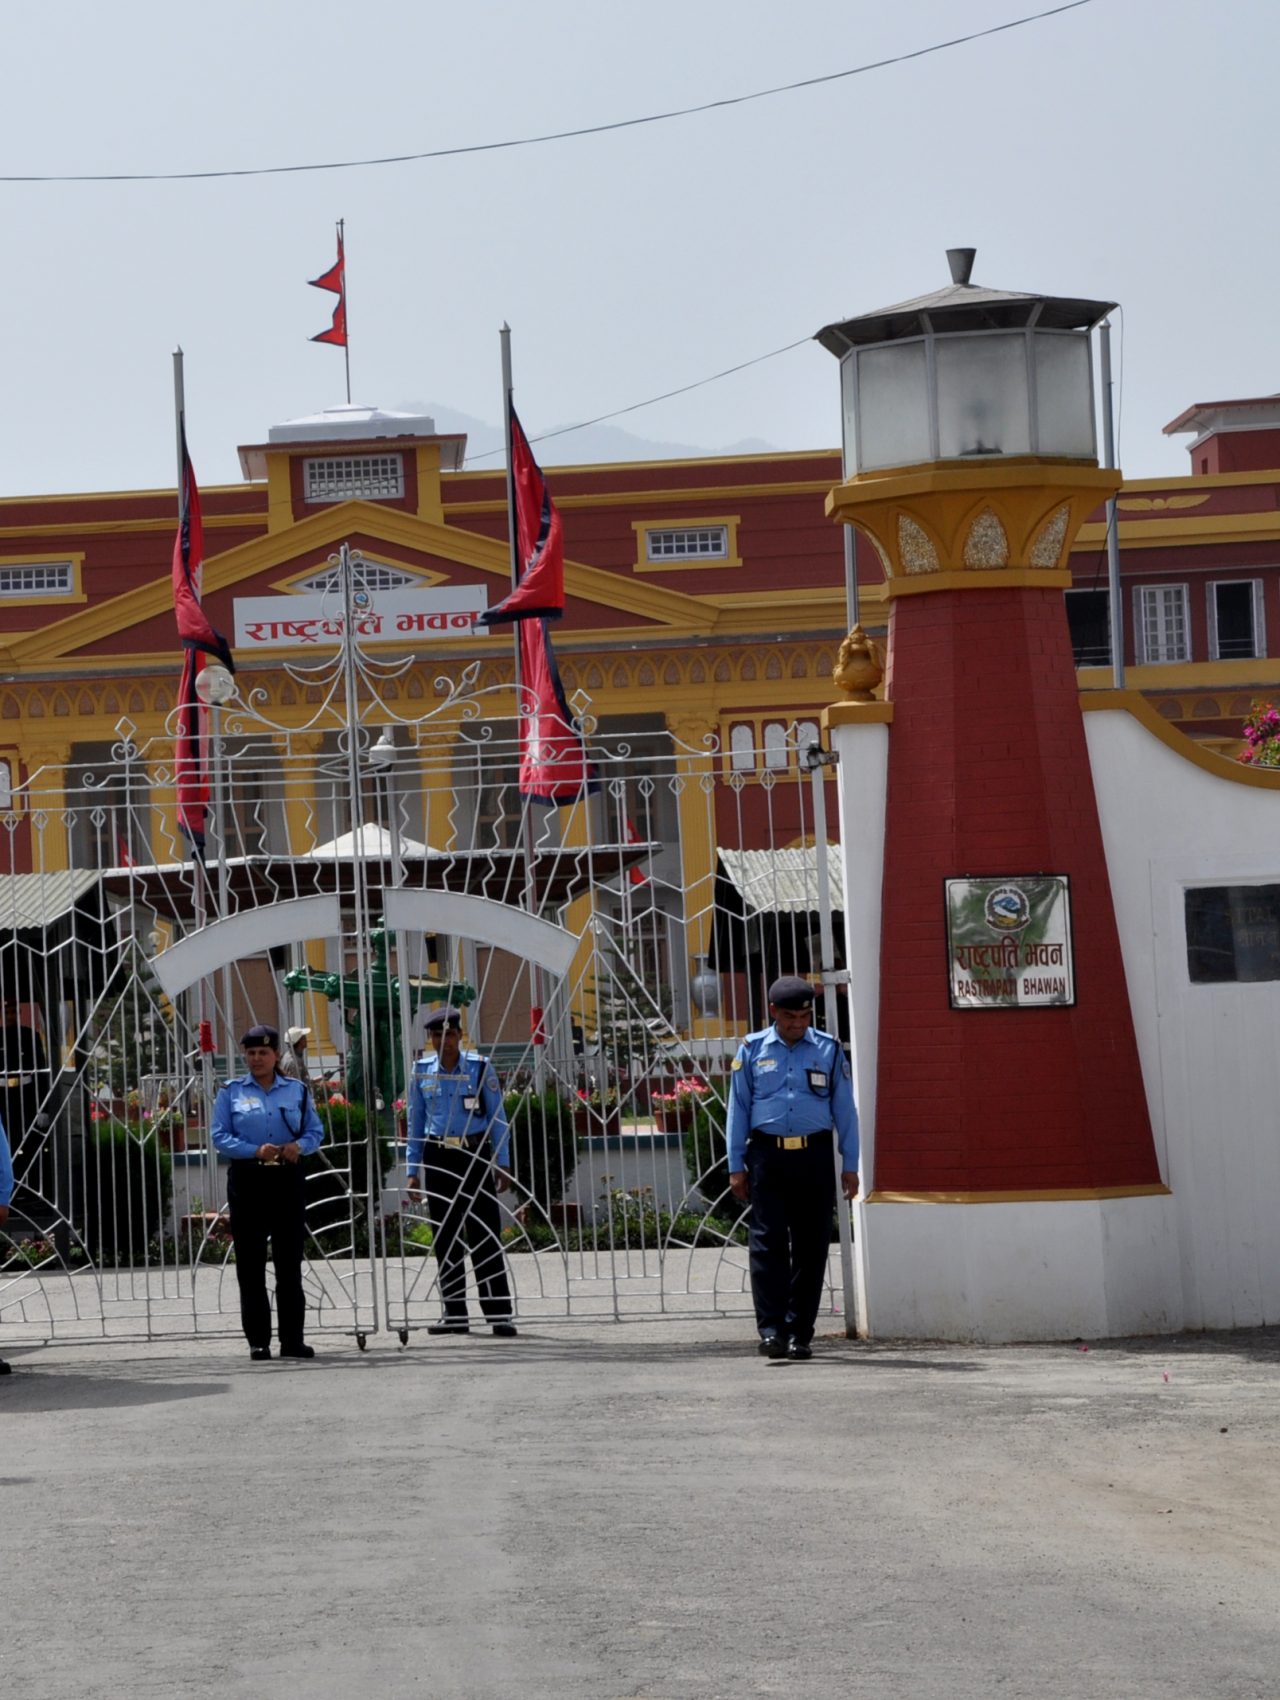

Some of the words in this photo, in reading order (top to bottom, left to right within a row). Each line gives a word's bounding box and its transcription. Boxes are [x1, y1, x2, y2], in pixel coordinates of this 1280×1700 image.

[396, 610, 480, 632] भवन
[956, 935, 1019, 976] राष्ट्रपति
[1024, 943, 1063, 967] भवन
[1023, 977, 1065, 995] BHAWAN
